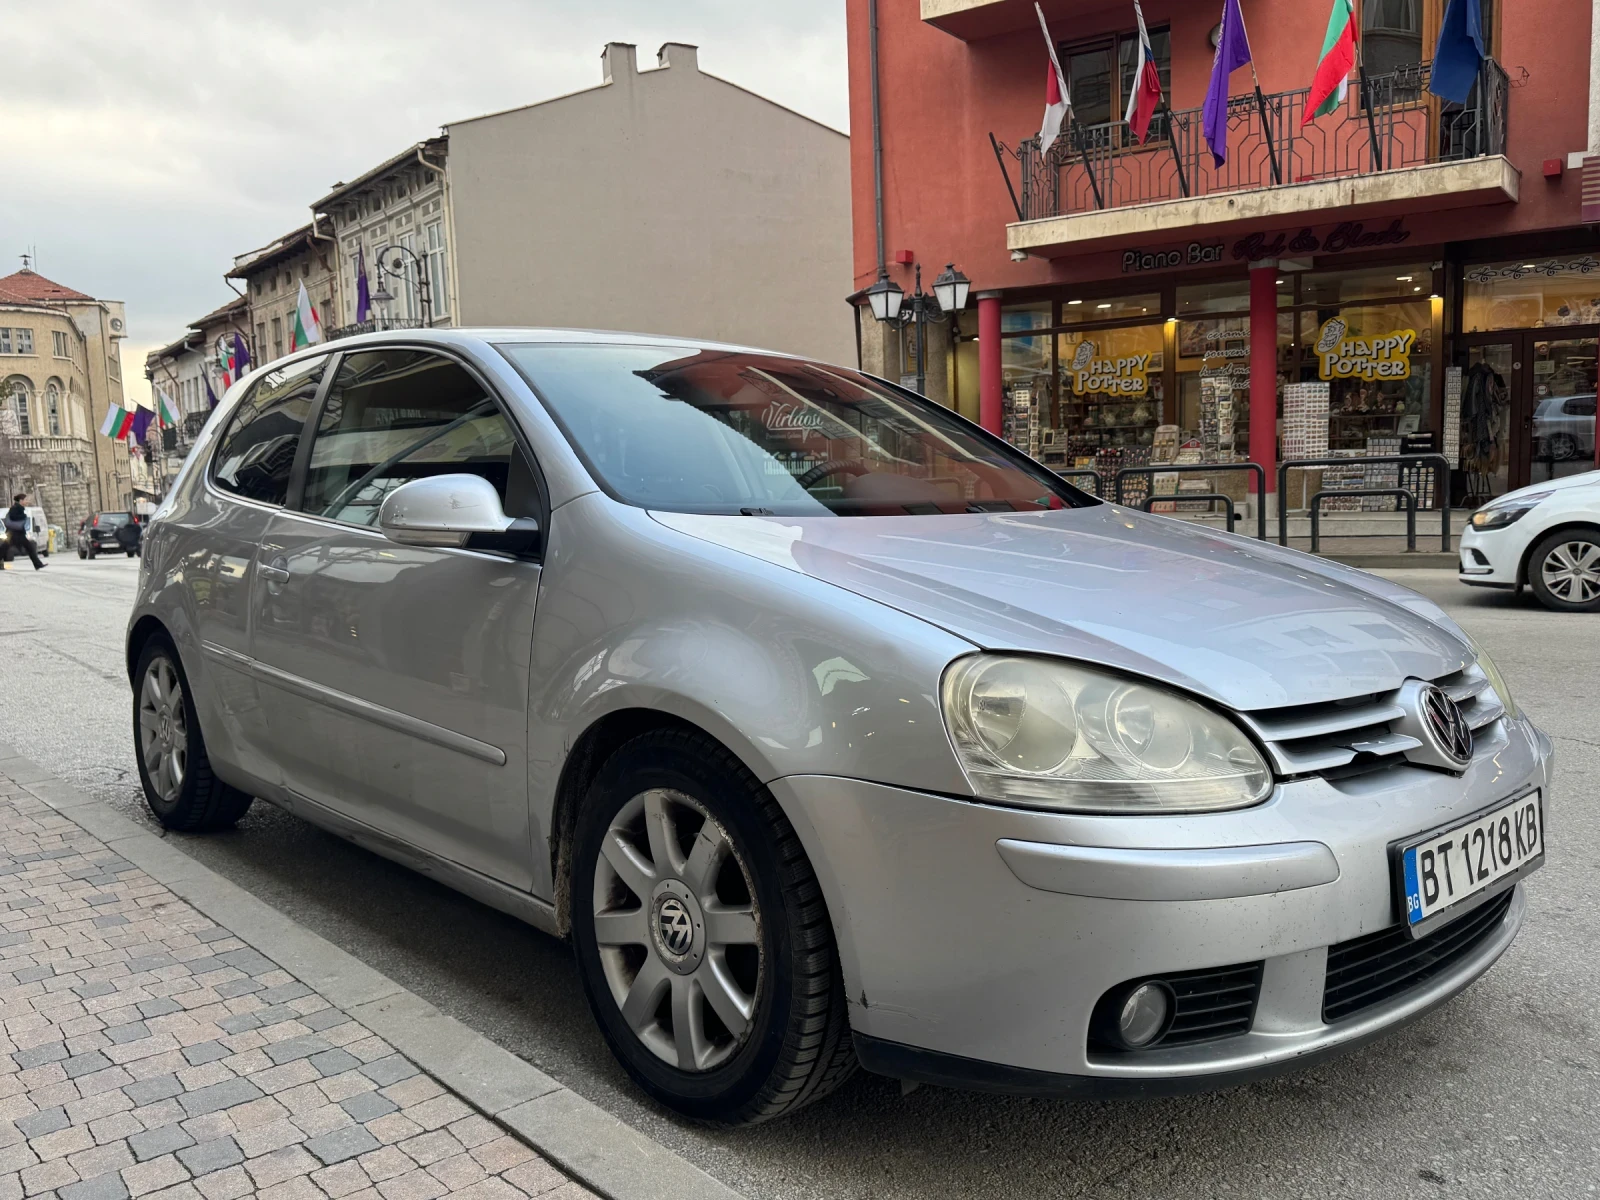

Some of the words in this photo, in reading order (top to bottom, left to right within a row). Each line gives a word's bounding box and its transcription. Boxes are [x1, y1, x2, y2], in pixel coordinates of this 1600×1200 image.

[1121, 249, 1182, 273] Piano
[1186, 241, 1225, 264] Bar
[1231, 232, 1287, 262] Red
[1321, 218, 1411, 254] Black
[1206, 328, 1250, 341] ceramic
[1204, 345, 1250, 360] souveni
[1324, 353, 1405, 377] POTTER
[1077, 370, 1144, 393] POTTER
[1407, 893, 1420, 913] BG
[1420, 839, 1454, 908] BT
[1461, 815, 1513, 887] 1218
[1514, 802, 1538, 858] KB
